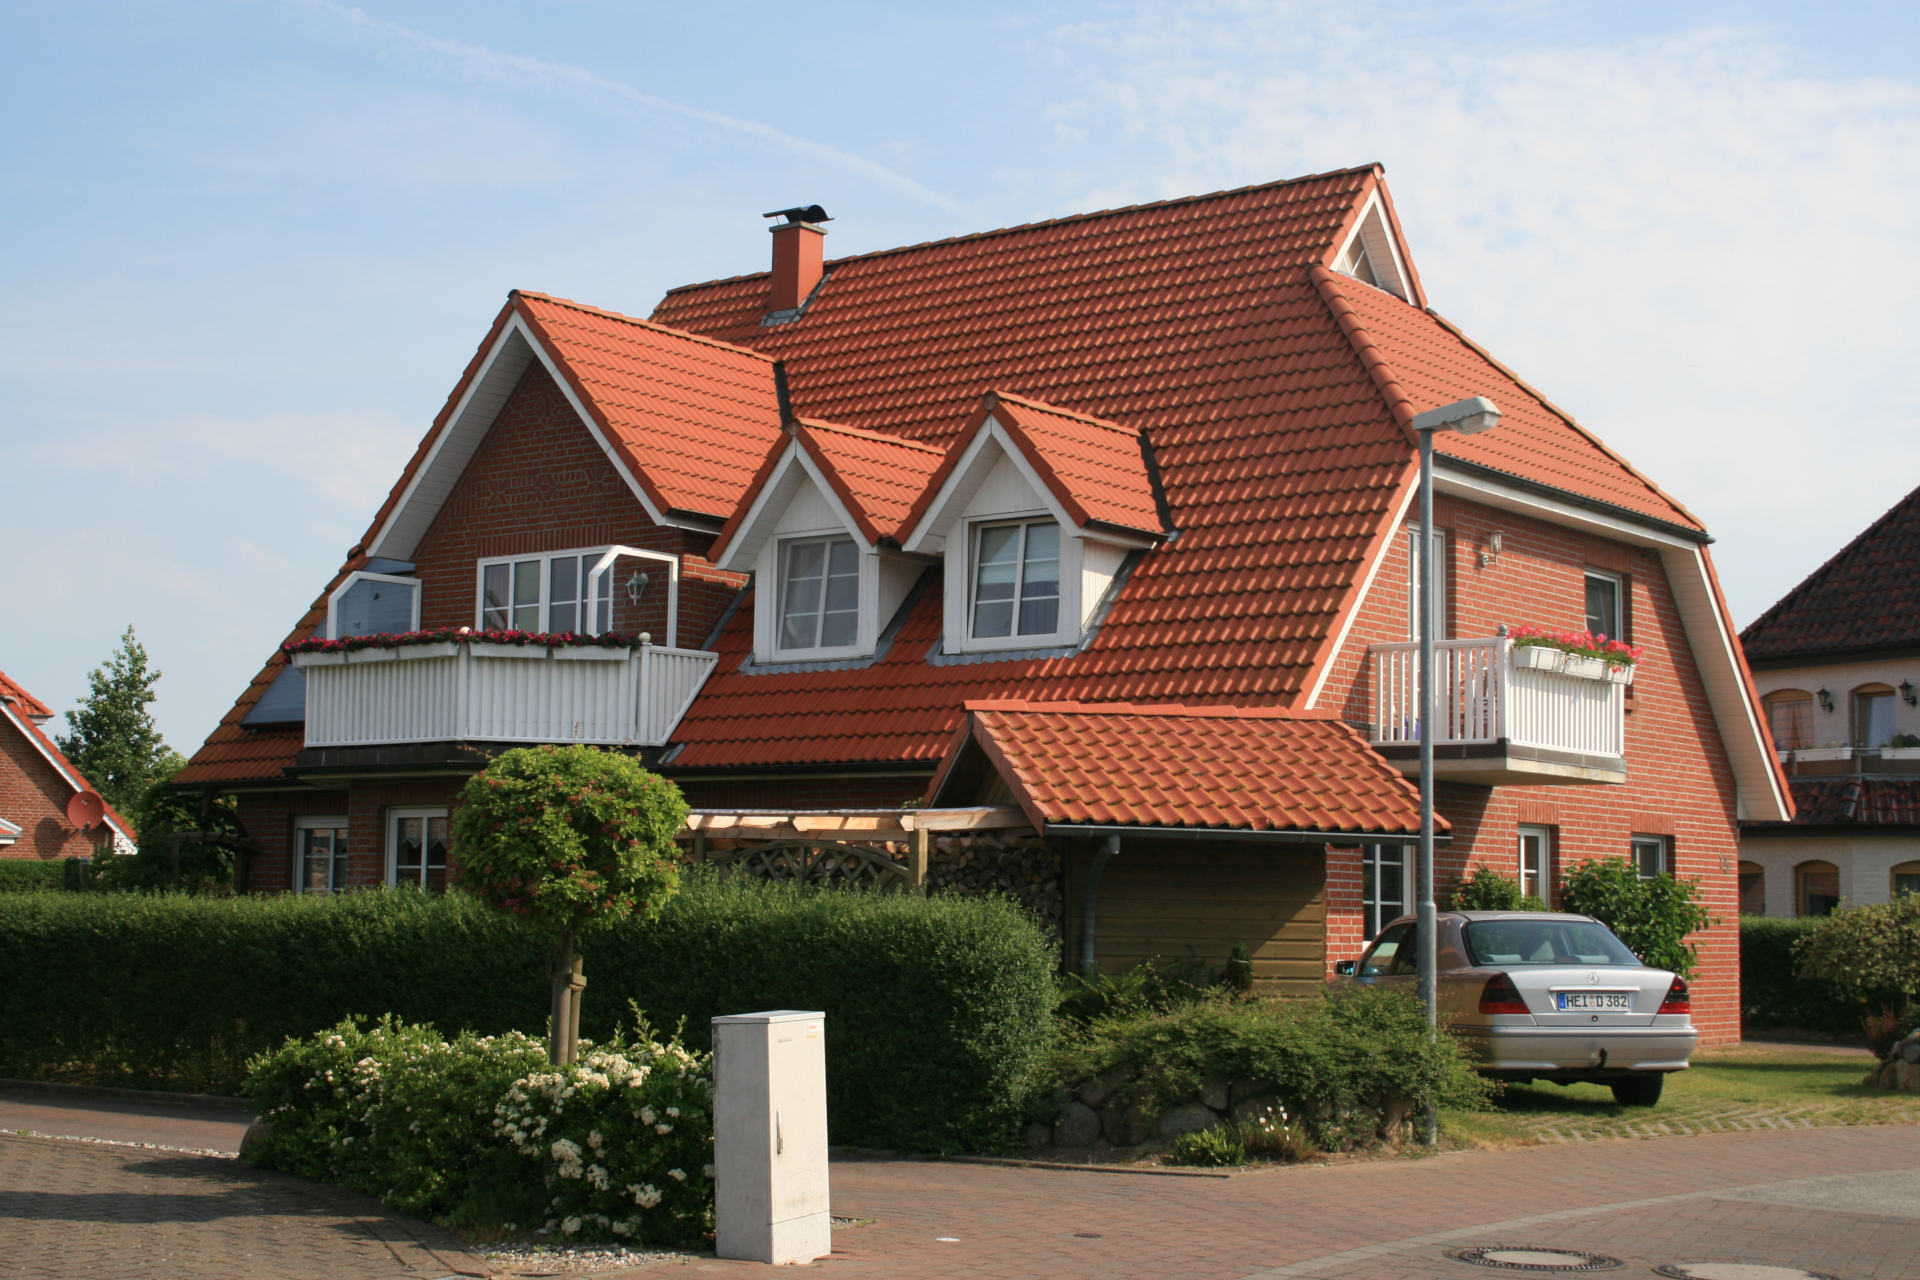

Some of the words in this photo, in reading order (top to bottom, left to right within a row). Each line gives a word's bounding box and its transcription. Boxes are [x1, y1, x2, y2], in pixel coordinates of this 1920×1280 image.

[1566, 995, 1588, 1007] HEI
[1596, 995, 1604, 1007] D
[1606, 995, 1628, 1007] 382
